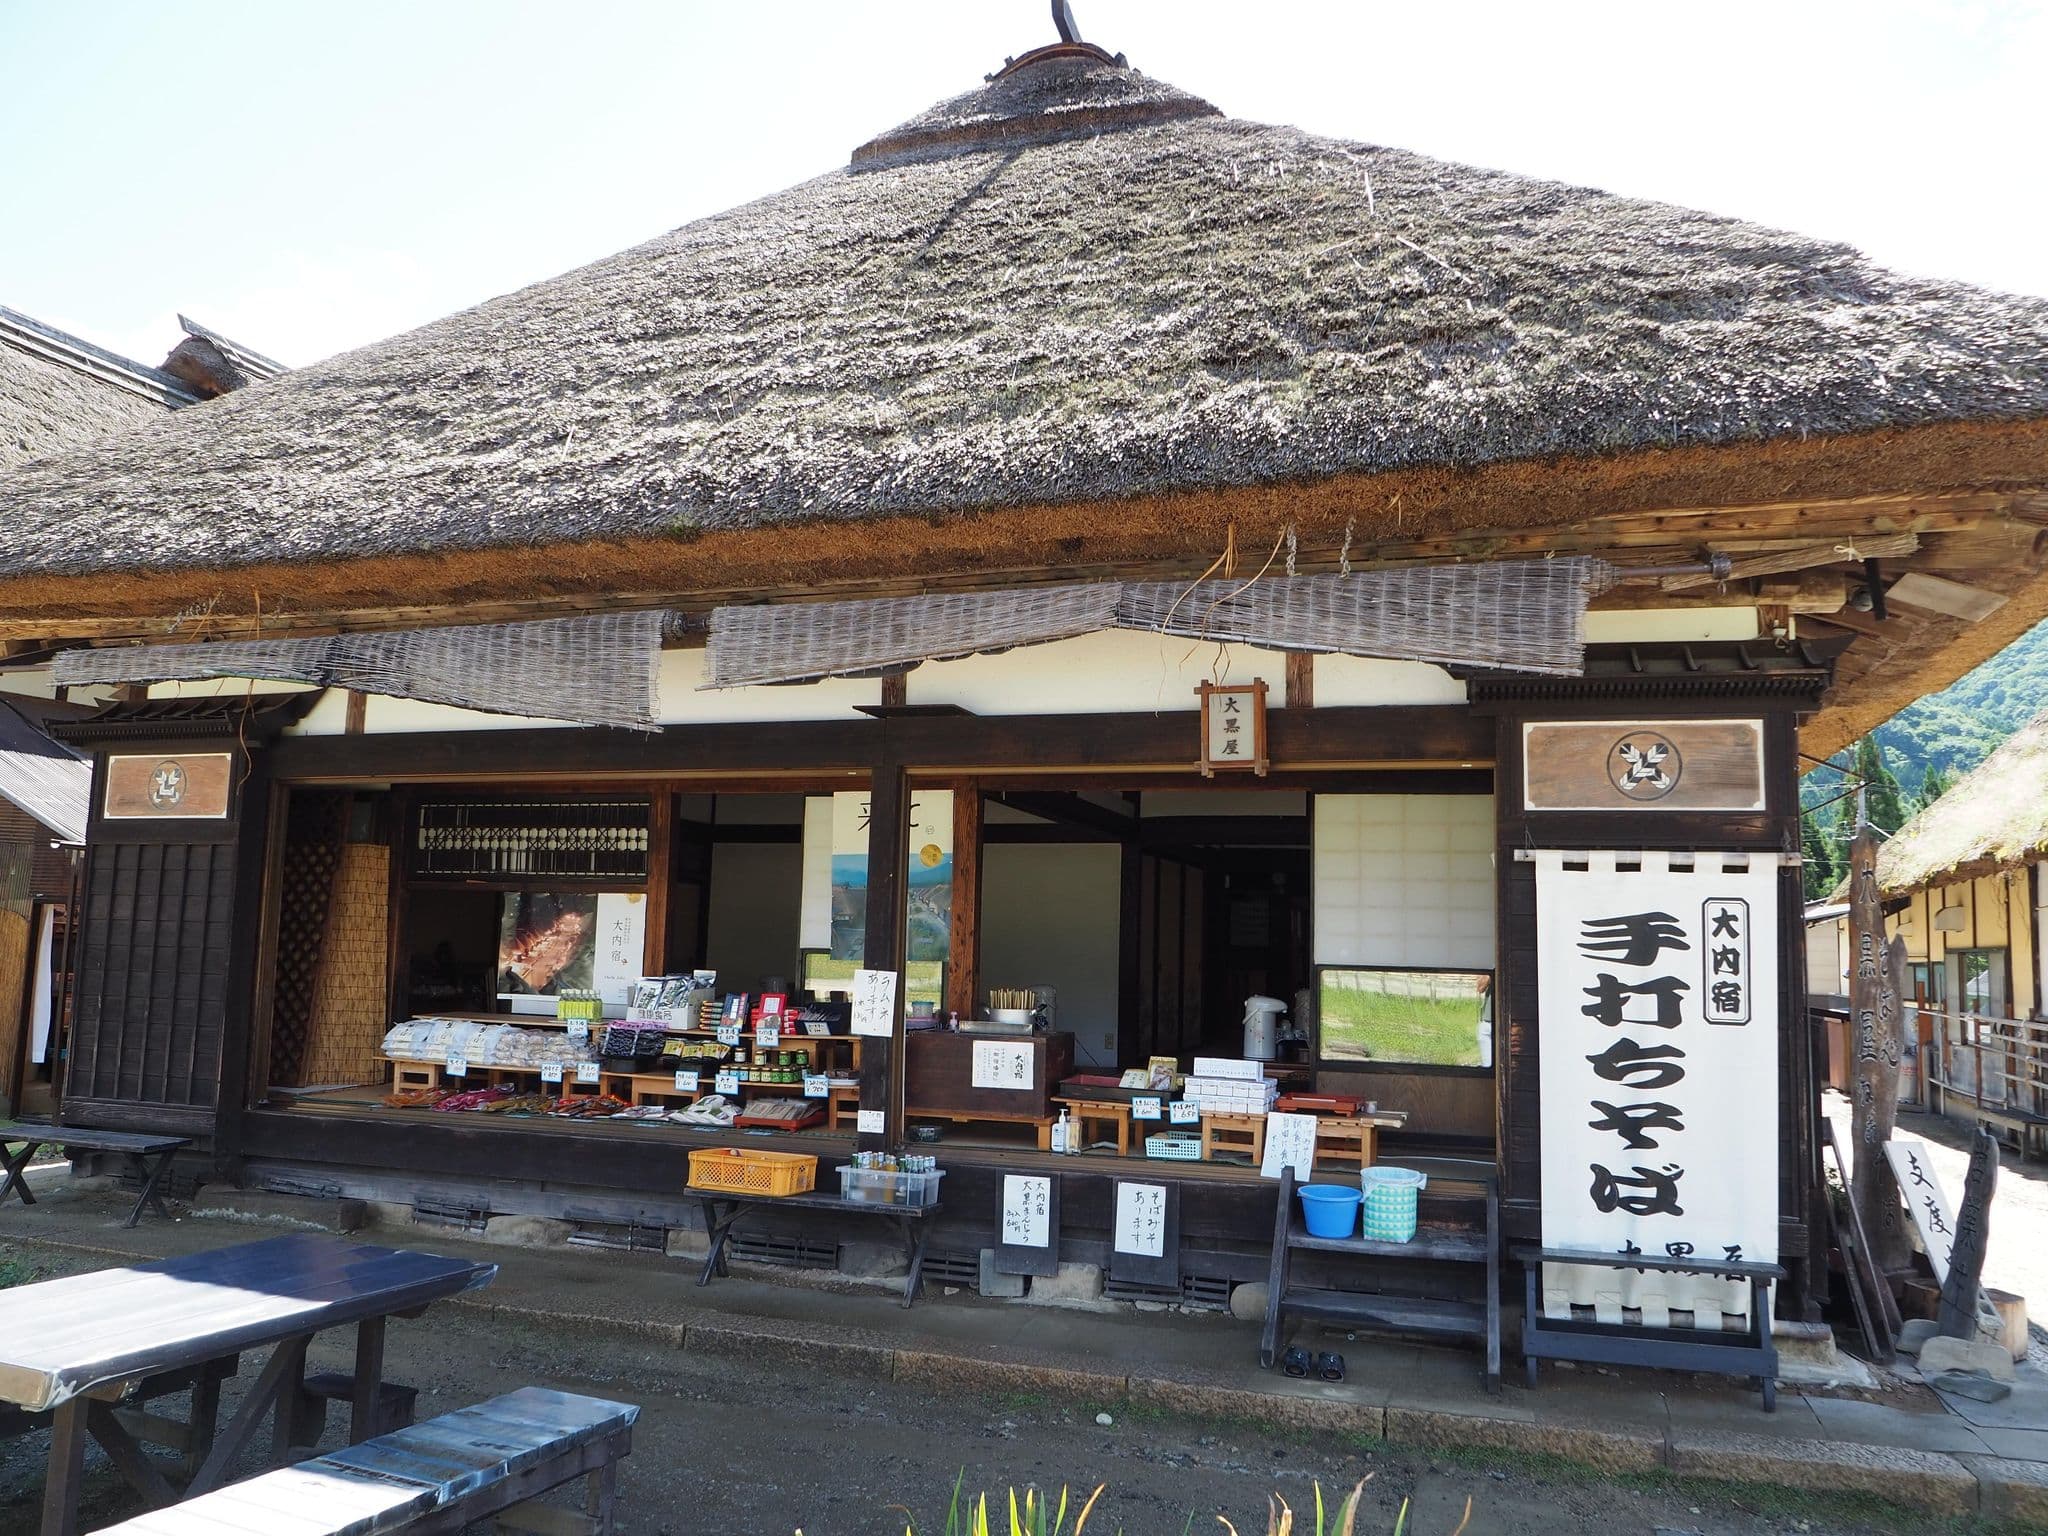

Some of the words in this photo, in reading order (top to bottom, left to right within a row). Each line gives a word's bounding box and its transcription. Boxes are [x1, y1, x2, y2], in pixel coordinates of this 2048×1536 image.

[1221, 696, 1241, 755] 大黒屋
[610, 919, 624, 962] 大内宿
[1710, 907, 1742, 1015] 大内宿
[1857, 863, 1877, 1062] 大黒屋
[1014, 1053, 1024, 1079] 大内宿
[1576, 910, 1691, 1218] 手打ちそば
[1035, 1182, 1046, 1216] 大内宿
[1131, 1190, 1145, 1249] あります
[1146, 1191, 1163, 1249] そばみそ
